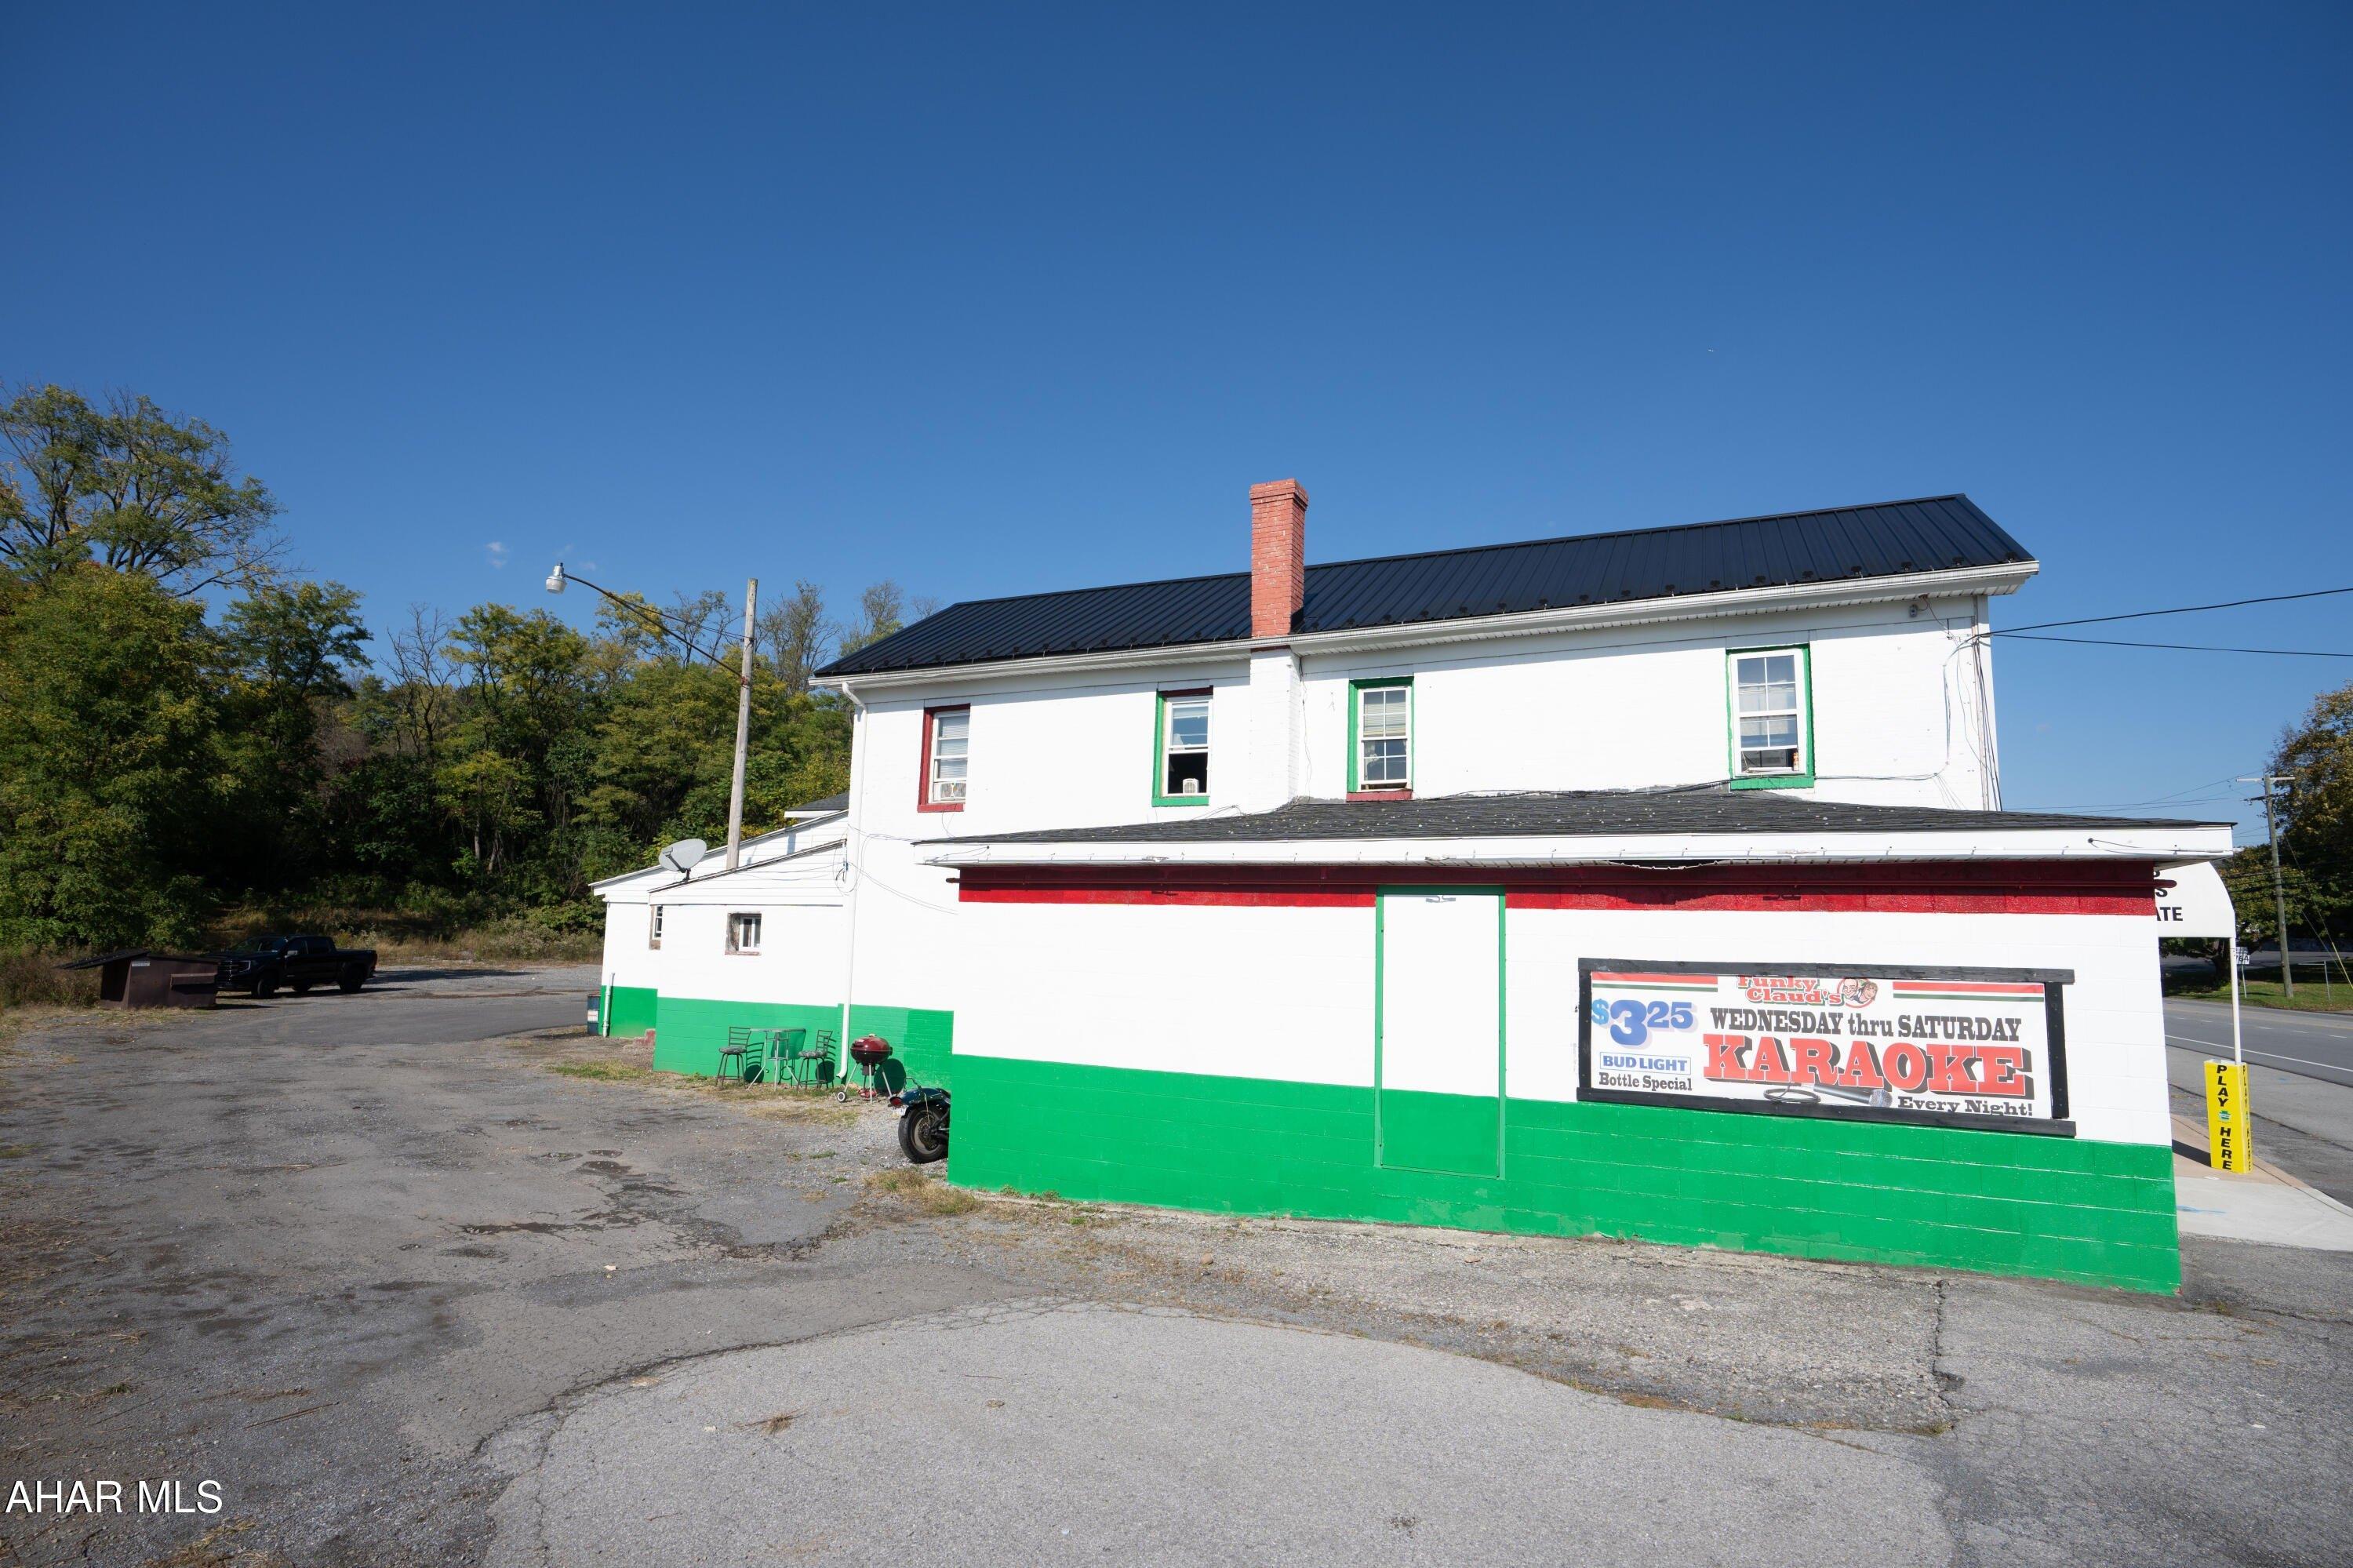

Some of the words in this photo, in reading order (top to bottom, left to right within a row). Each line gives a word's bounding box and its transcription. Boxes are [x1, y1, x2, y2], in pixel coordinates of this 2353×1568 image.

[1737, 975, 1819, 992] Funky
[1746, 988, 1844, 1005] Claud's
[1710, 1007, 1844, 1035] WEDNESDAY
[1848, 1013, 1894, 1037] thru
[1897, 1014, 2022, 1042] SATURDAY
[1602, 1055, 1637, 1068] BUD
[1639, 1057, 1688, 1072] LIGHT
[1703, 1033, 2031, 1098] KARAOKE
[1598, 1071, 1640, 1088] Bottle
[1642, 1075, 1693, 1092] Special
[2217, 1064, 2229, 1107] PLAY
[1897, 1096, 1961, 1113] Every
[1964, 1099, 2033, 1117] Night!
[2220, 1126, 2232, 1170] HERE
